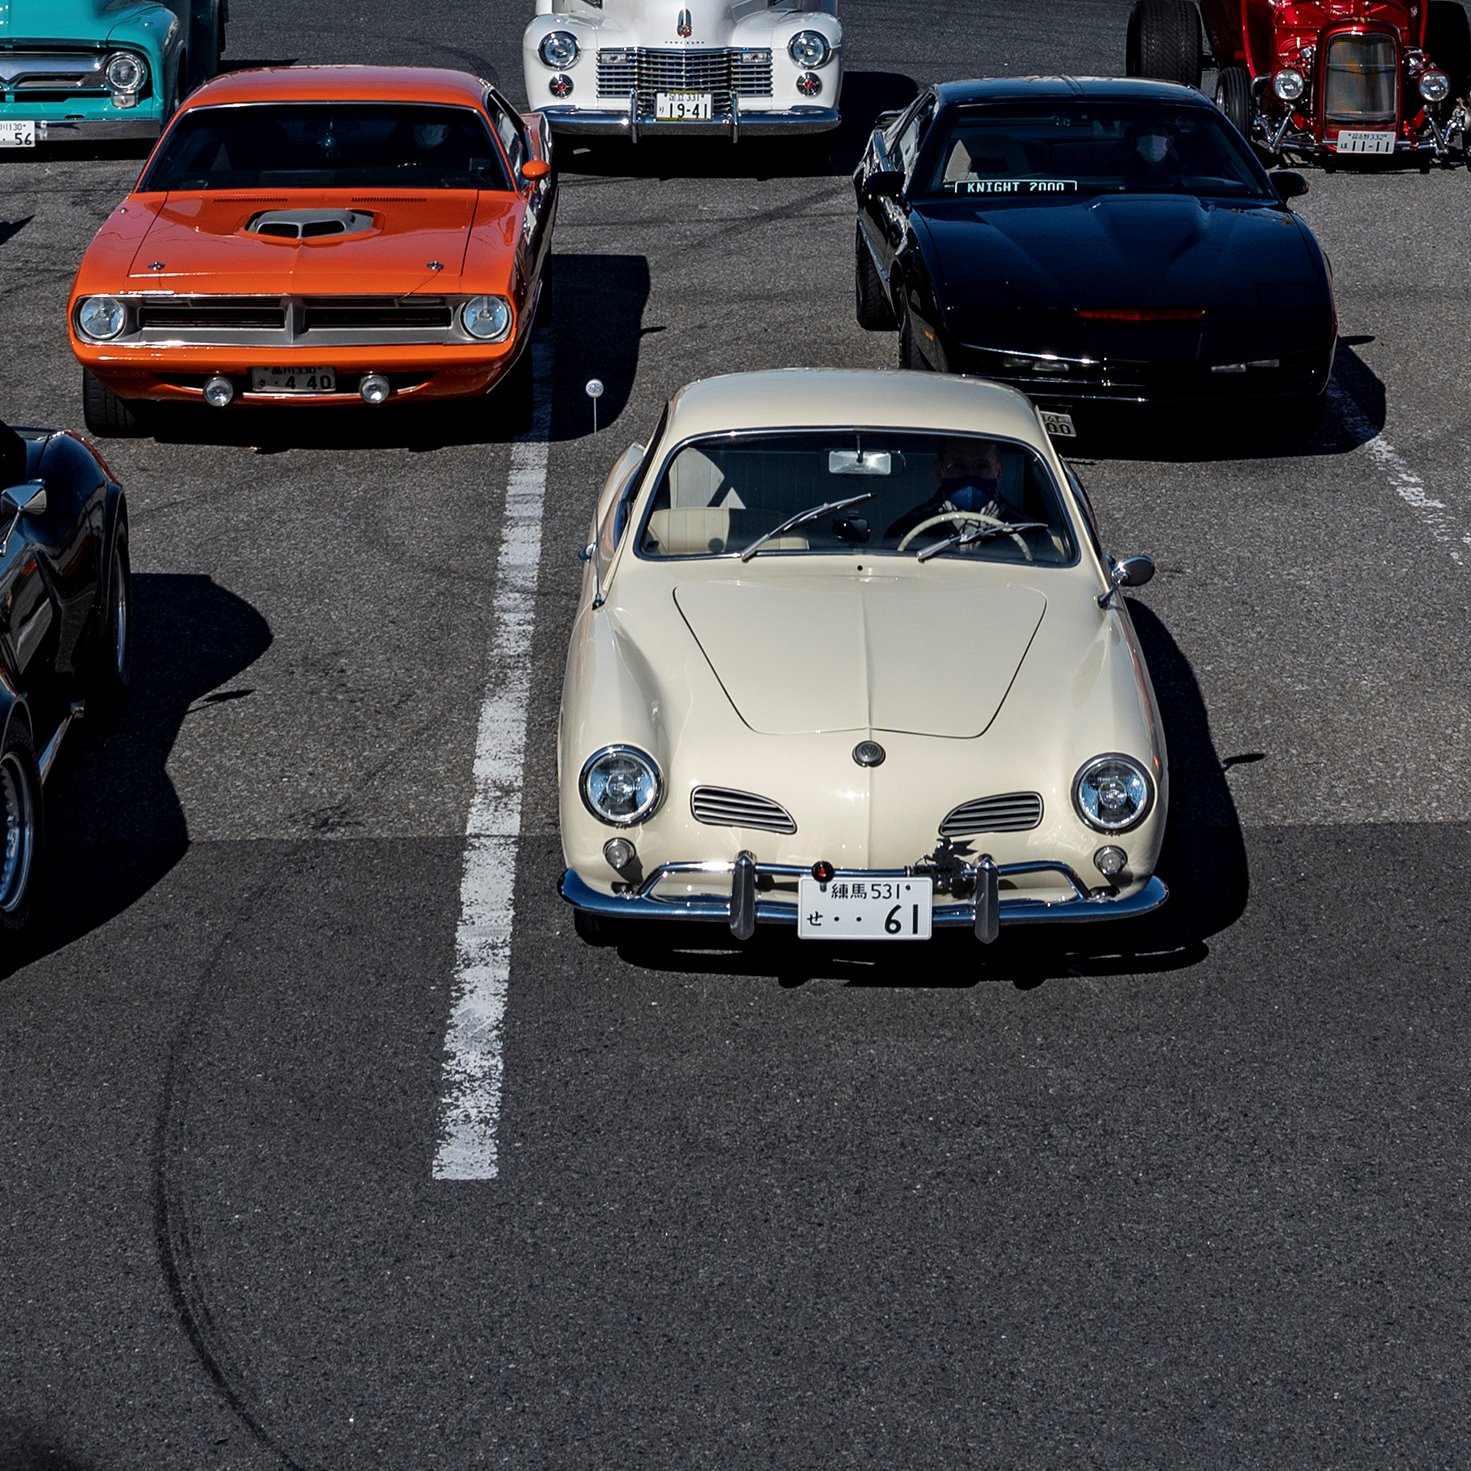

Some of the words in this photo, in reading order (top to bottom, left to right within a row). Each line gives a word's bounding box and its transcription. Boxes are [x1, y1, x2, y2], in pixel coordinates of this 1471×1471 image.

[670, 103, 708, 118] 19-41
[14, 133, 32, 145] 56
[1352, 140, 1390, 152] 11-11
[967, 182, 1020, 192] KNIGHT
[1029, 182, 1065, 192] 2000
[807, 910, 823, 926] せ
[884, 904, 919, 934] 61
